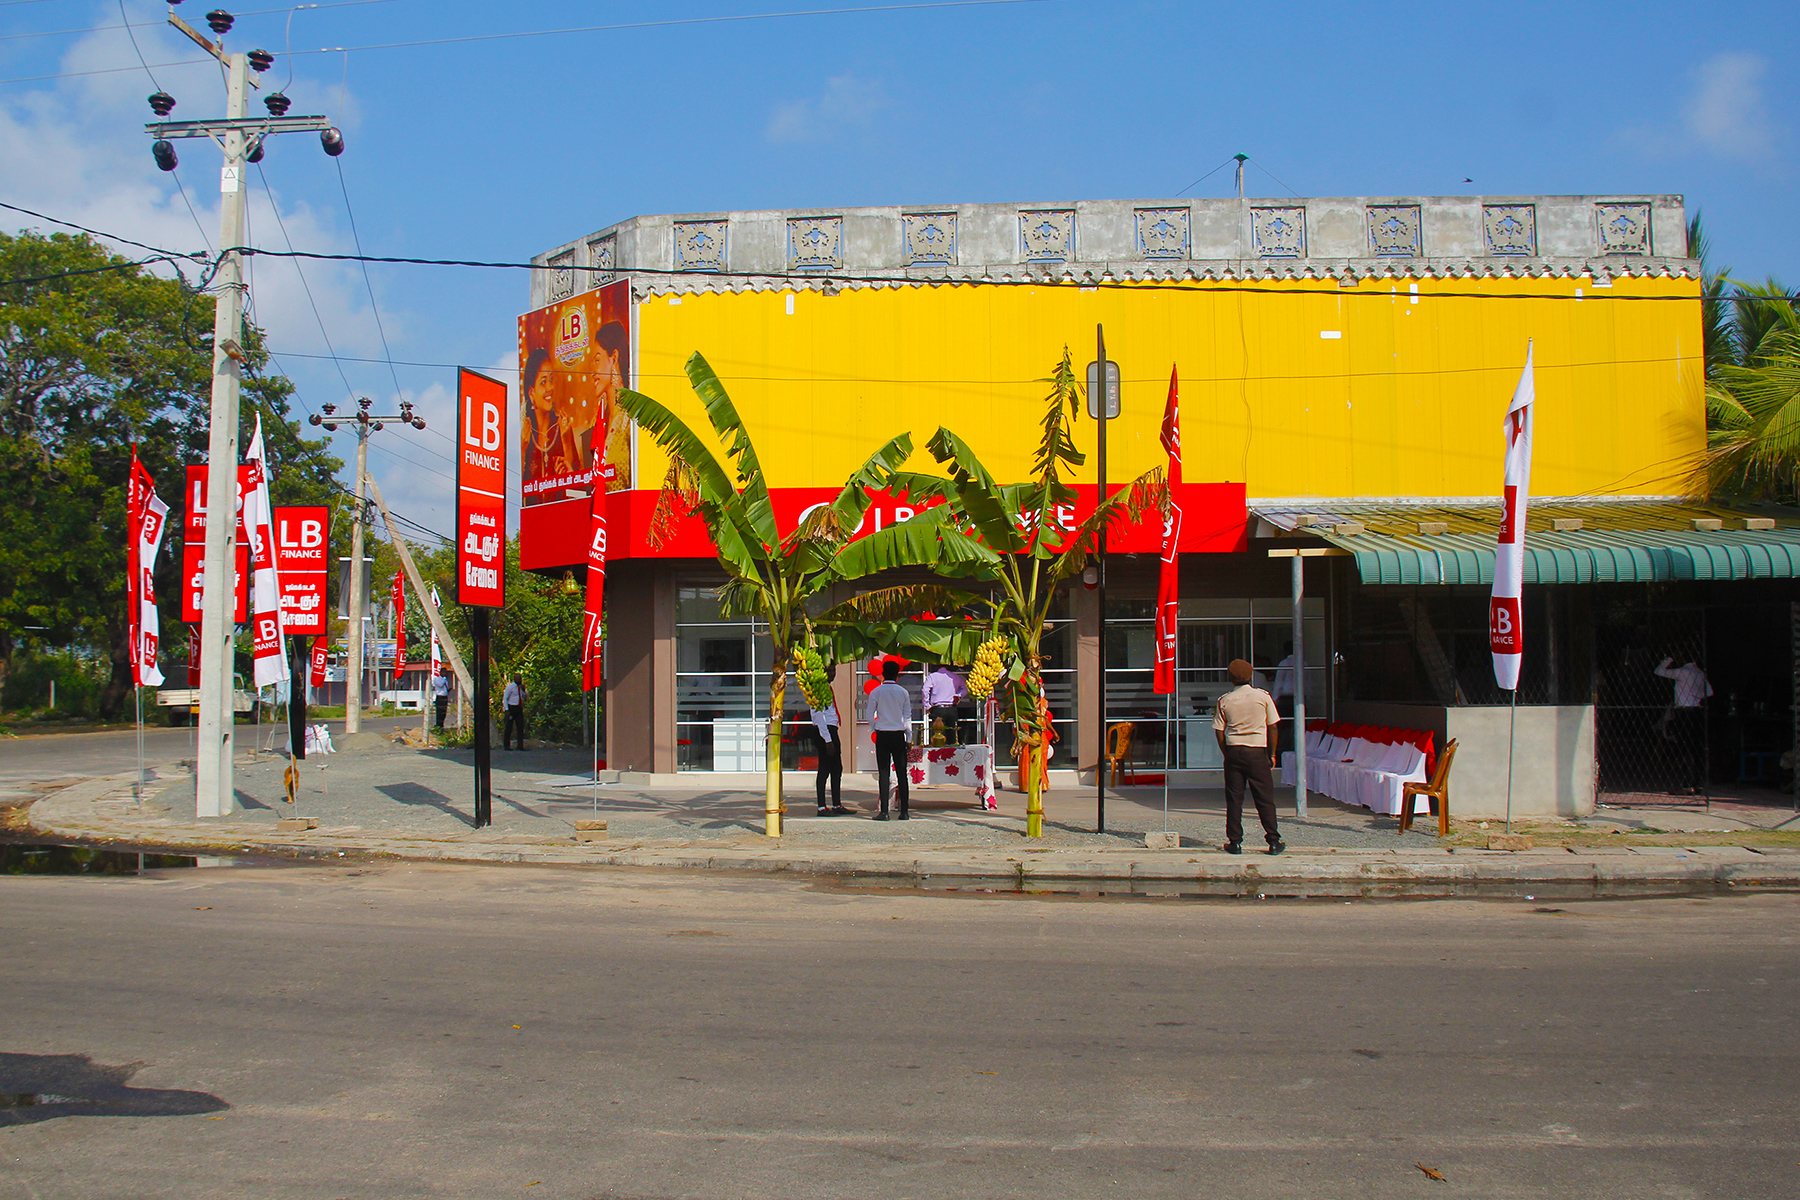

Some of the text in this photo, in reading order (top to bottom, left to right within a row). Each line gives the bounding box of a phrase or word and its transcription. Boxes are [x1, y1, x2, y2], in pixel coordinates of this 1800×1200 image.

[561, 313, 582, 342] LB
[465, 396, 500, 451] LB
[465, 450, 500, 472] FINANCE
[280, 520, 322, 547] LB
[464, 531, 499, 562] அடகுச்
[280, 549, 322, 559] FINANCE
[466, 560, 498, 590] சேவை
